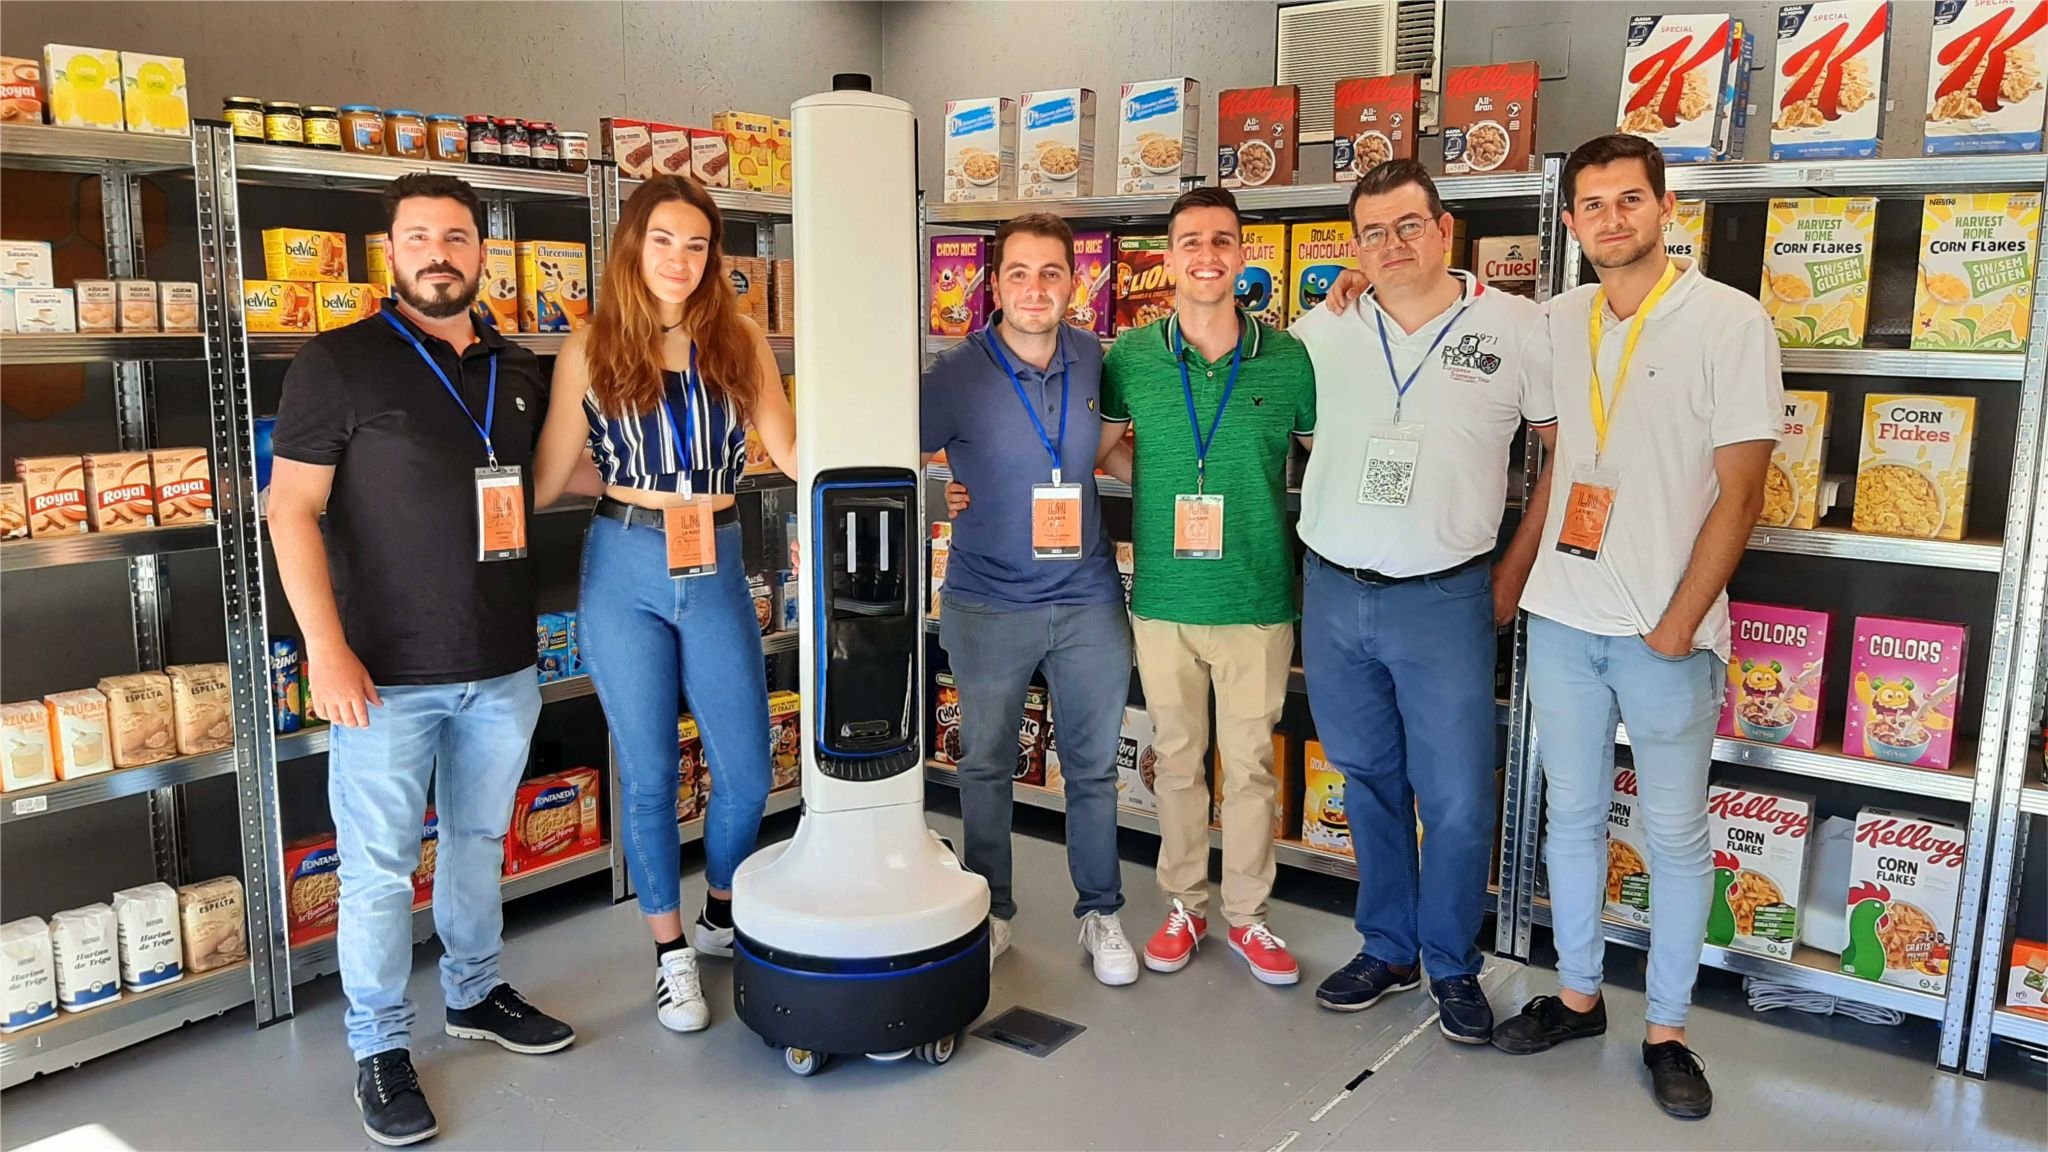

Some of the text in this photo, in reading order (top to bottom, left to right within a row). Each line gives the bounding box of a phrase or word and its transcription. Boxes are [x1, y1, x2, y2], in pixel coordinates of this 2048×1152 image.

[1813, 12, 1849, 22] SPECIAL
[1474, 103, 1494, 112] Bran
[1477, 96, 1493, 105] All-
[1797, 219, 1843, 231] HARVEST
[1955, 215, 2004, 228] HARVEST
[1310, 228, 1345, 243] BOLAS DE
[1804, 230, 1833, 242] HOME
[1962, 228, 1995, 240] HOME
[6, 250, 39, 258] Sacarina
[285, 240, 318, 257] belVita
[936, 242, 977, 257] CHOCO RICE
[1085, 239, 1103, 254] RICE
[1773, 242, 1808, 256] CORN
[1930, 240, 1967, 254] CORN
[1485, 258, 1538, 277] Cruesl
[1813, 260, 1861, 279] SIN/SEM
[1972, 256, 2024, 278] SIN/SEM
[1130, 264, 1177, 293] LION
[1816, 270, 1863, 292] GLUTEN
[1976, 267, 2026, 292] GLUTEN
[322, 291, 357, 309] belVita
[1890, 406, 1943, 424] CORN
[1878, 423, 1951, 443] Flakes
[102, 485, 145, 504] Royal
[162, 479, 204, 499] Royal
[35, 490, 79, 510] Royal
[1740, 619, 1809, 648] COLORS
[1869, 635, 1943, 664] COLORS
[125, 690, 163, 703] ESPELTA
[191, 682, 227, 696] ESPELTA
[937, 704, 961, 724] CHOC
[535, 787, 576, 806] FONTANEDA
[1607, 814, 1630, 827] AKES
[1707, 790, 1809, 838] Kellogg
[1727, 827, 1765, 846] CORN
[1855, 819, 1965, 868] Kellogg
[1726, 840, 1763, 856] FLAKES
[301, 853, 340, 872] FONTANE
[1876, 856, 1919, 876] CORN
[1876, 870, 1917, 887] FLAKES
[199, 897, 235, 914] ESPELTA
[140, 930, 172, 942] Harina
[153, 938, 175, 948] Trigo
[76, 948, 109, 961] Harina
[1905, 942, 1932, 952] GRATIS
[89, 956, 112, 967] Trigo
[9, 975, 48, 990] de Trigo
[10, 968, 46, 983] Harina
